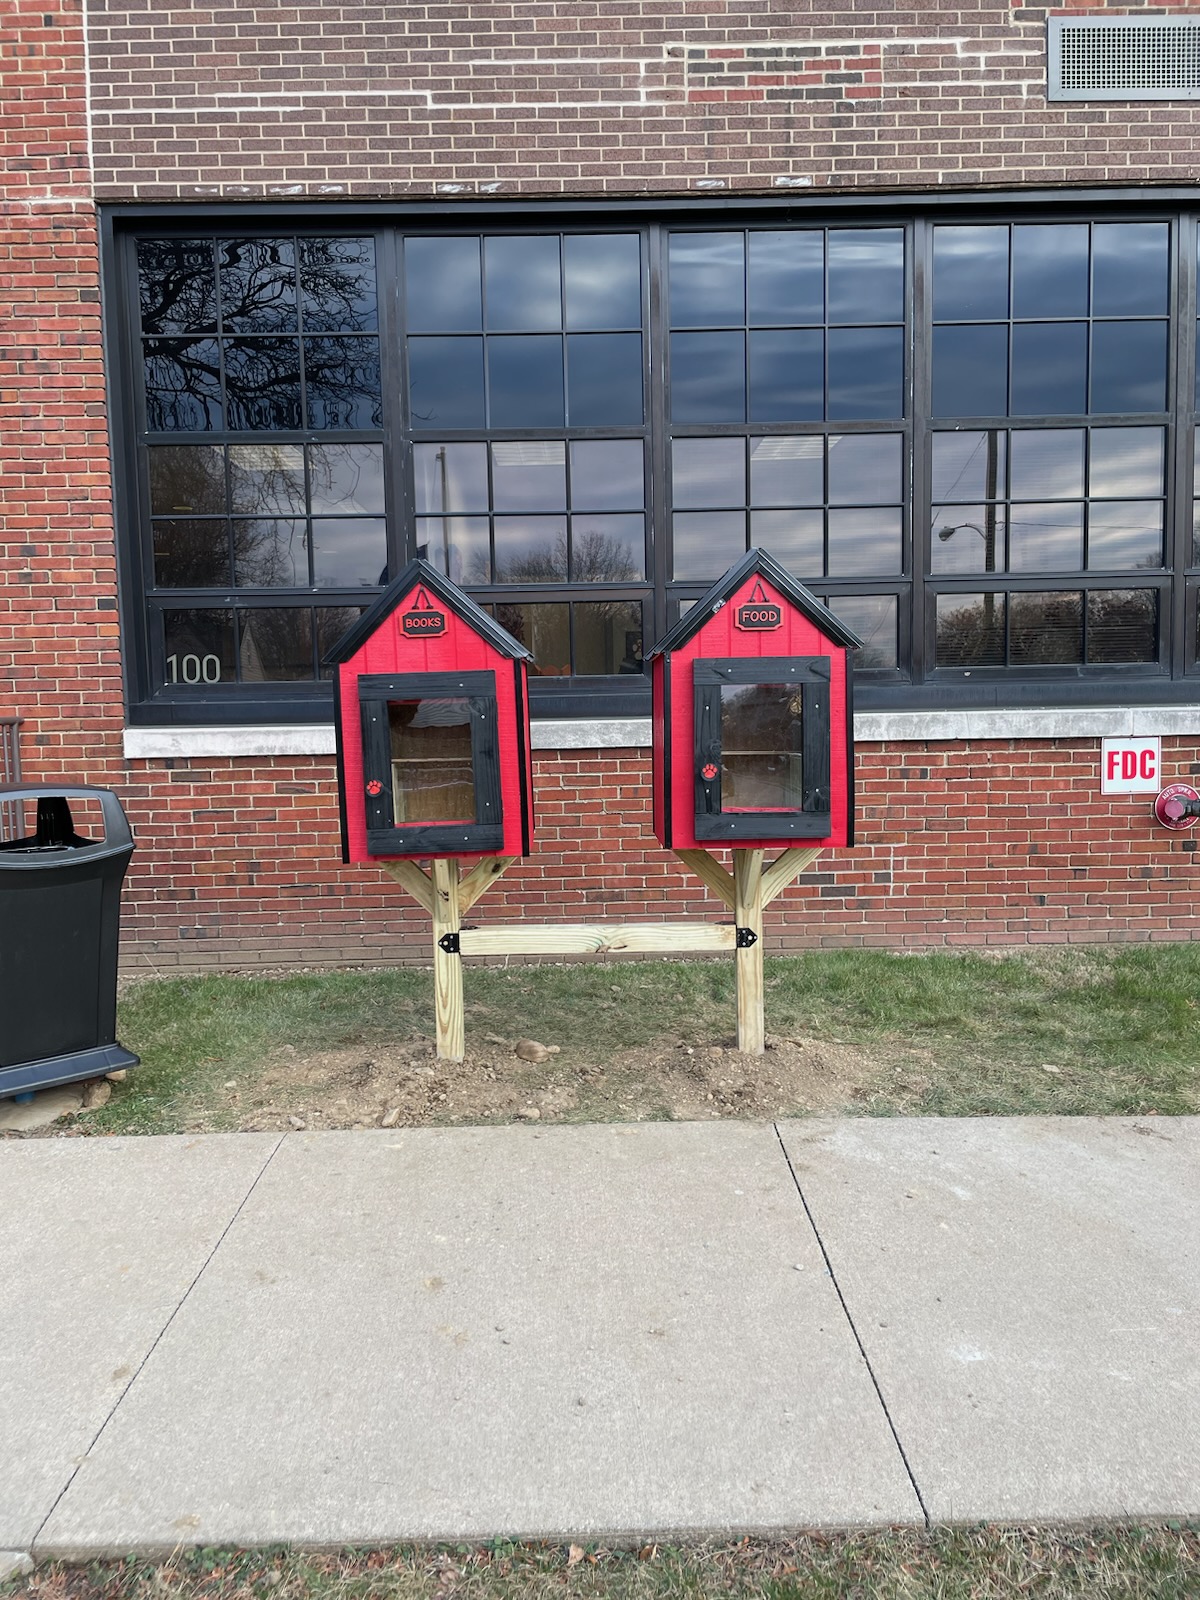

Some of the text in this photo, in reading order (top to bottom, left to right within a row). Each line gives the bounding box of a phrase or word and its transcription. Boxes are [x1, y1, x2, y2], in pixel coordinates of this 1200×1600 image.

[406, 617, 441, 628] BOOKS
[742, 611, 778, 622] FOOD
[166, 653, 221, 684] 100
[1107, 749, 1155, 780] FDC
